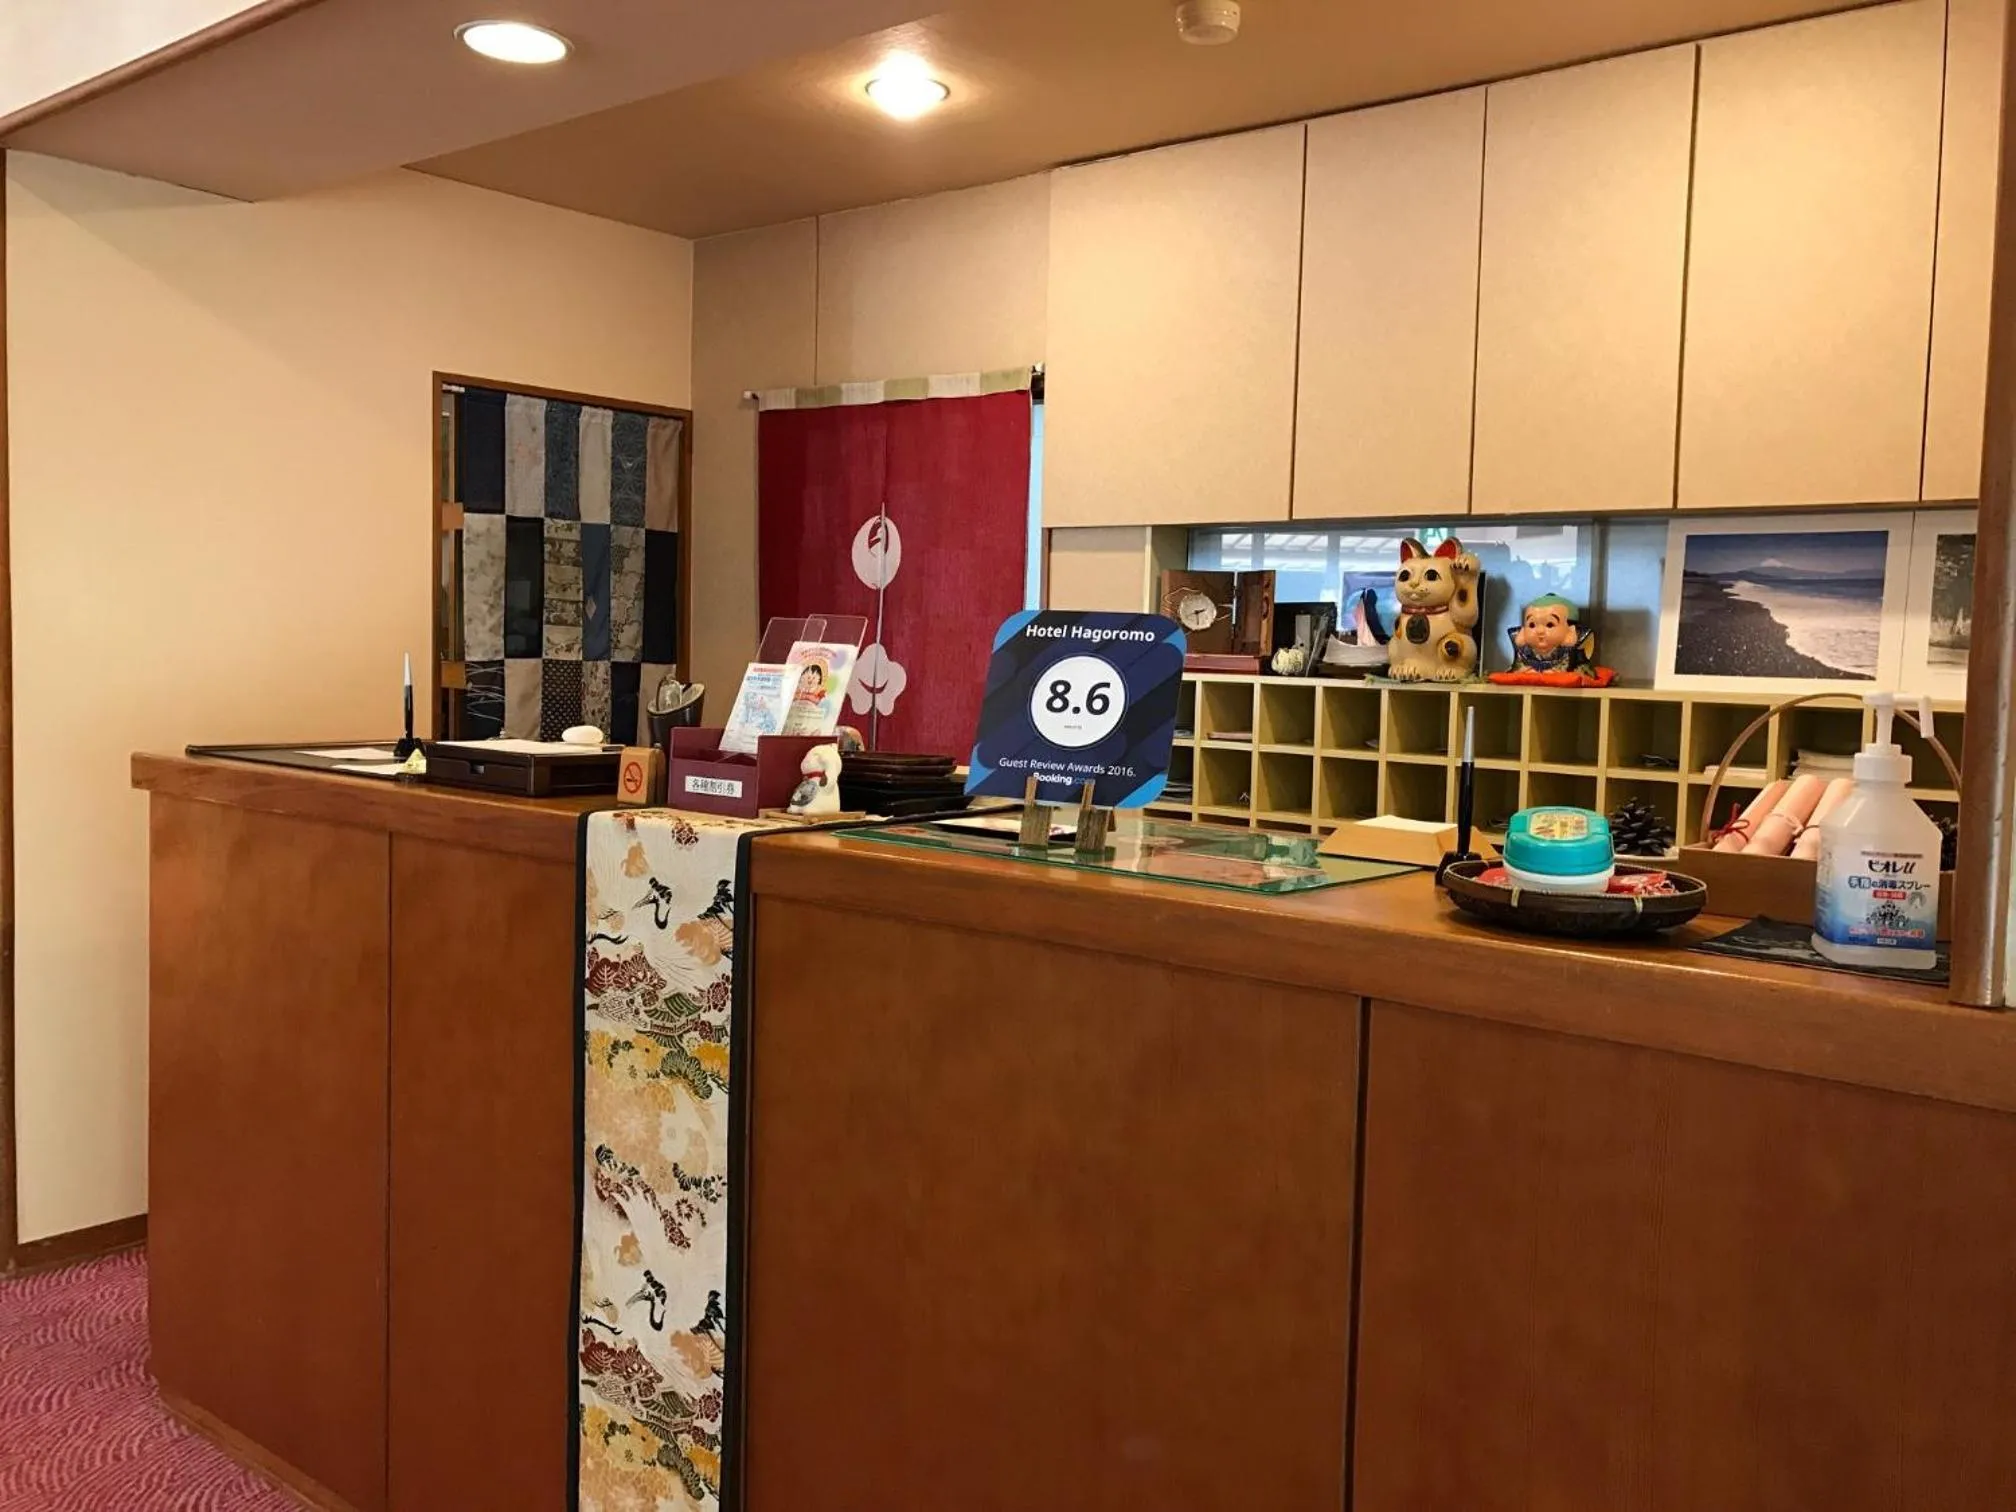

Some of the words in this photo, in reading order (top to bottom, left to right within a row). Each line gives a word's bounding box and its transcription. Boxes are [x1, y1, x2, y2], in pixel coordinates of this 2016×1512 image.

[1026, 624, 1067, 639] Hotel
[1071, 625, 1155, 643] Hagoromo
[1045, 679, 1111, 716] 8.6
[999, 757, 1028, 769] Guest
[1030, 758, 1065, 771] Review
[1067, 761, 1105, 774] Awards
